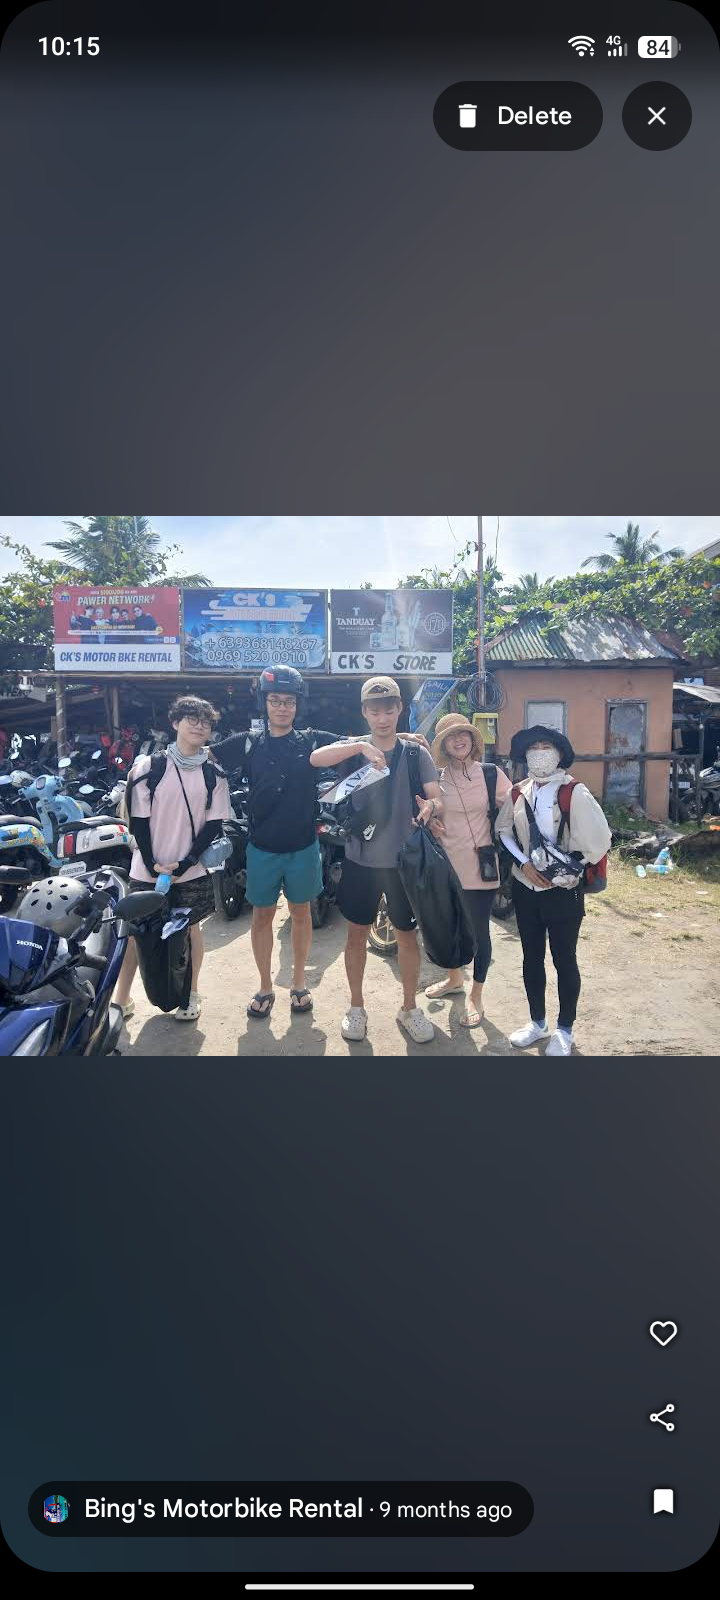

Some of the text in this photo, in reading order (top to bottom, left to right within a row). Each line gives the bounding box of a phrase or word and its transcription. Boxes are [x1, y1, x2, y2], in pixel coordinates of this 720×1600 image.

[78, 596, 106, 606] PAWER
[336, 617, 375, 626] TANDUAY
[60, 652, 172, 663] CK'S MOTOR BKE RENTAL
[207, 650, 307, 663] 0969 520 0910
[337, 654, 437, 671] CK'S STORE
[15, 939, 43, 951] HONDA
